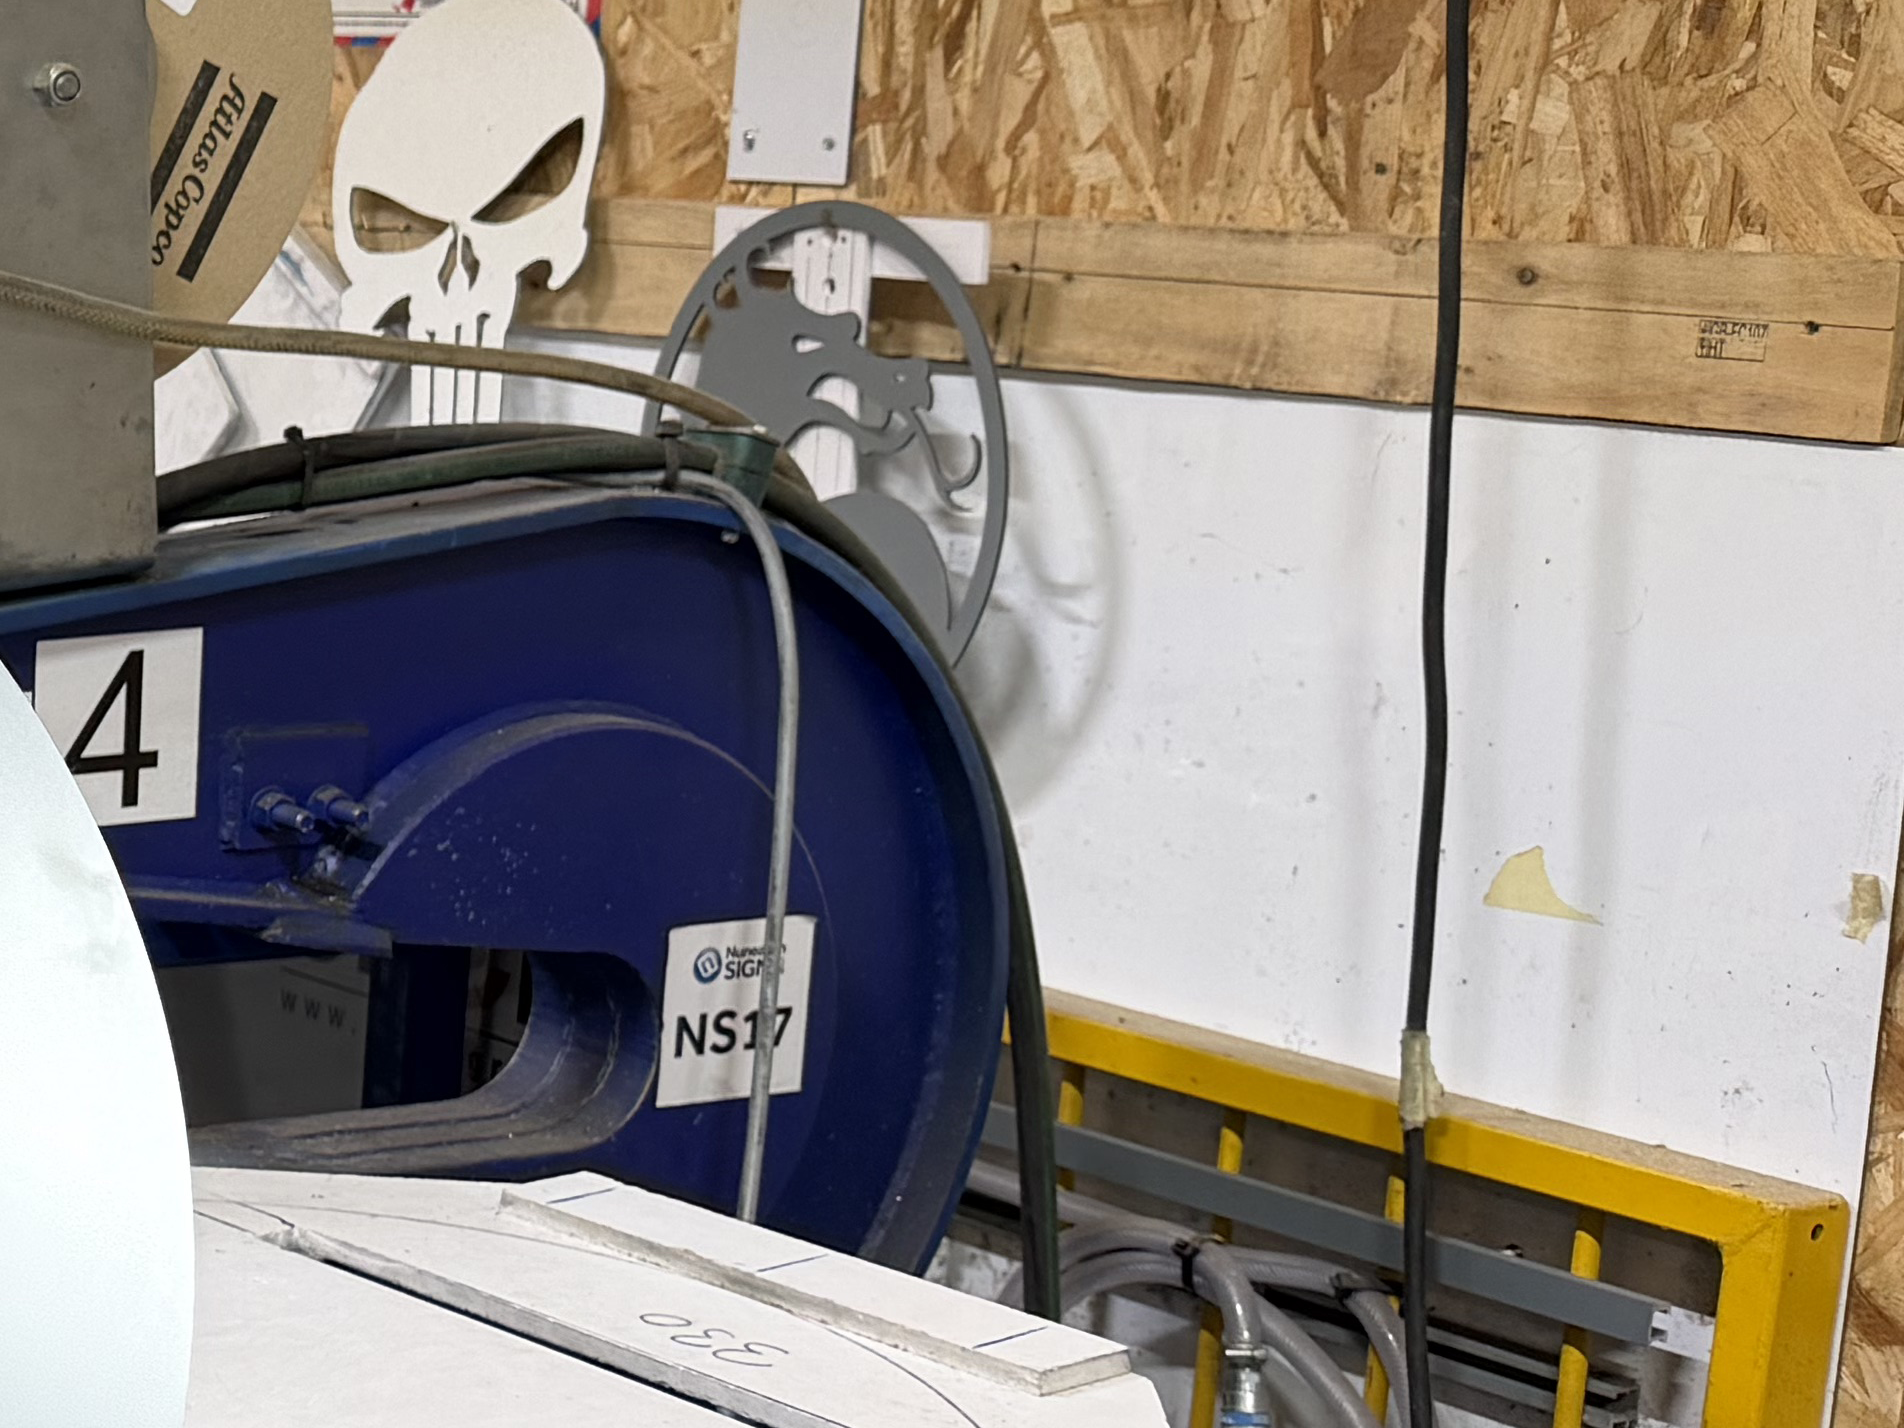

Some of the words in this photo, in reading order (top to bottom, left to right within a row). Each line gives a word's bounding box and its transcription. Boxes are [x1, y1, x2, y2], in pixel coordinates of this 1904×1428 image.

[190, 73, 248, 178] Atlas
[149, 168, 207, 267] Copco
[68, 649, 160, 808] 4
[674, 1006, 794, 1059] NS17
